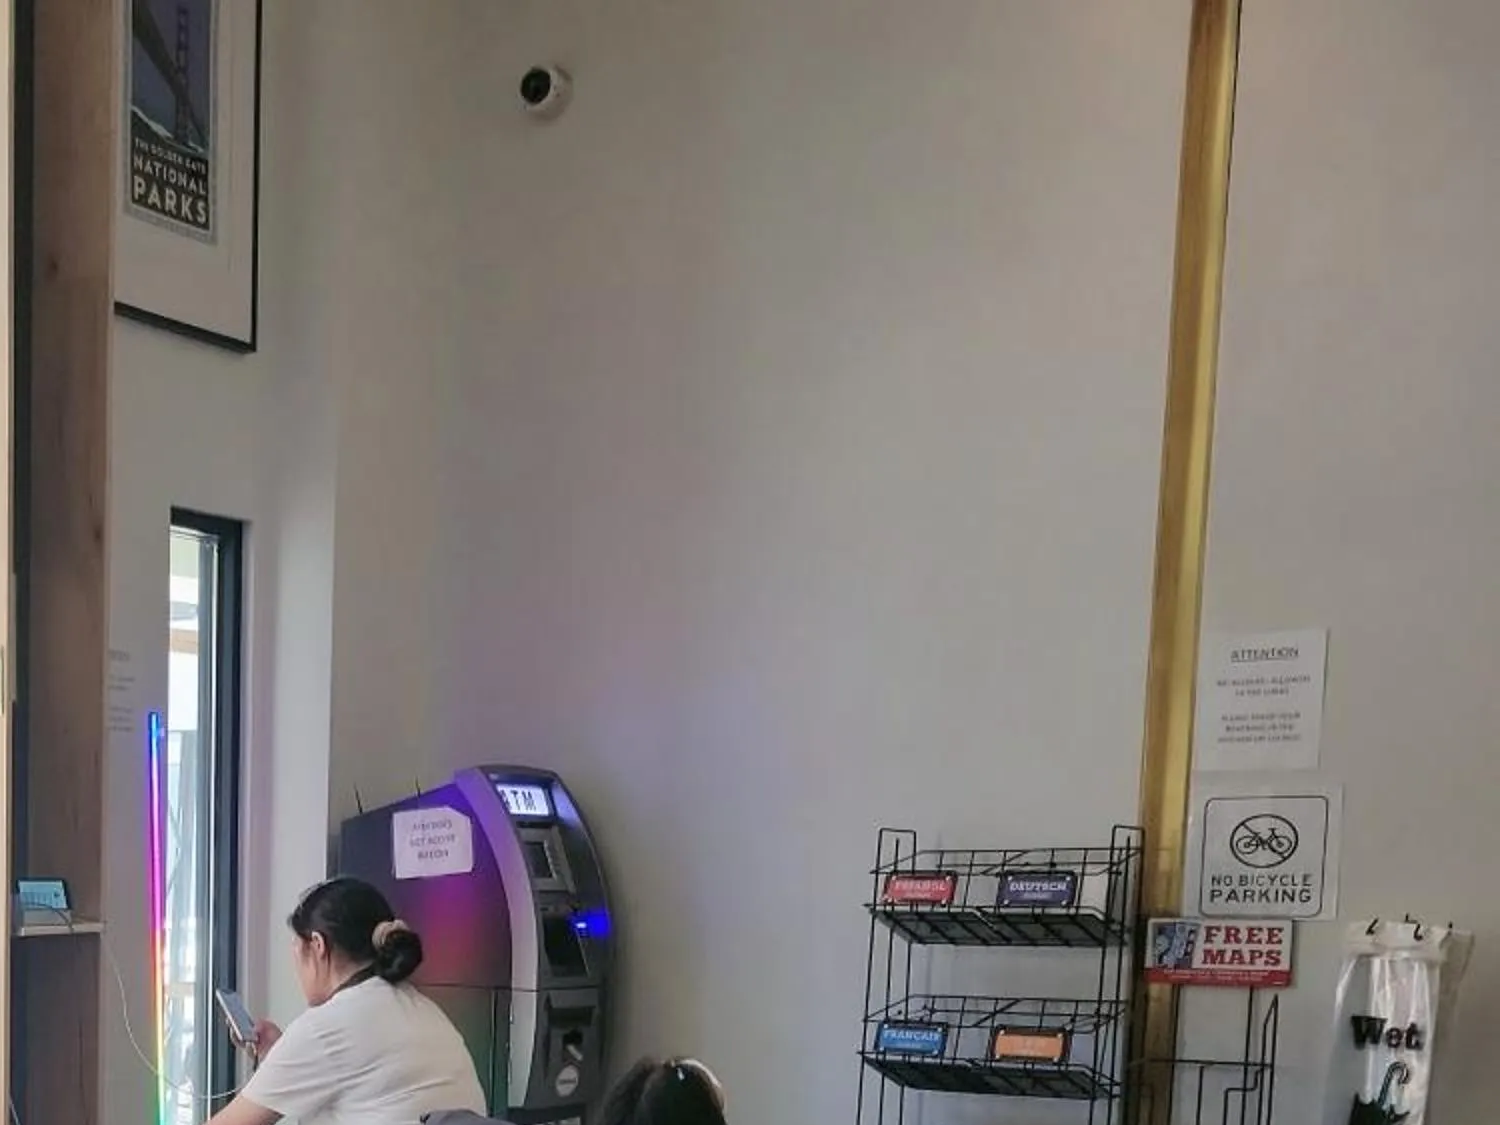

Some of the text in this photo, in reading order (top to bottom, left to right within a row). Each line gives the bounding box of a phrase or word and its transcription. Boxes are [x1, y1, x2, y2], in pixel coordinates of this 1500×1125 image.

[133, 154, 206, 195] NATIONAL
[133, 175, 206, 225] PARKS
[1211, 873, 1313, 887] NO BICYCLE
[1210, 888, 1312, 903] PARKING
[1204, 925, 1284, 945] FREE
[1201, 949, 1283, 966] MAPS
[1350, 1015, 1424, 1051] Wet
